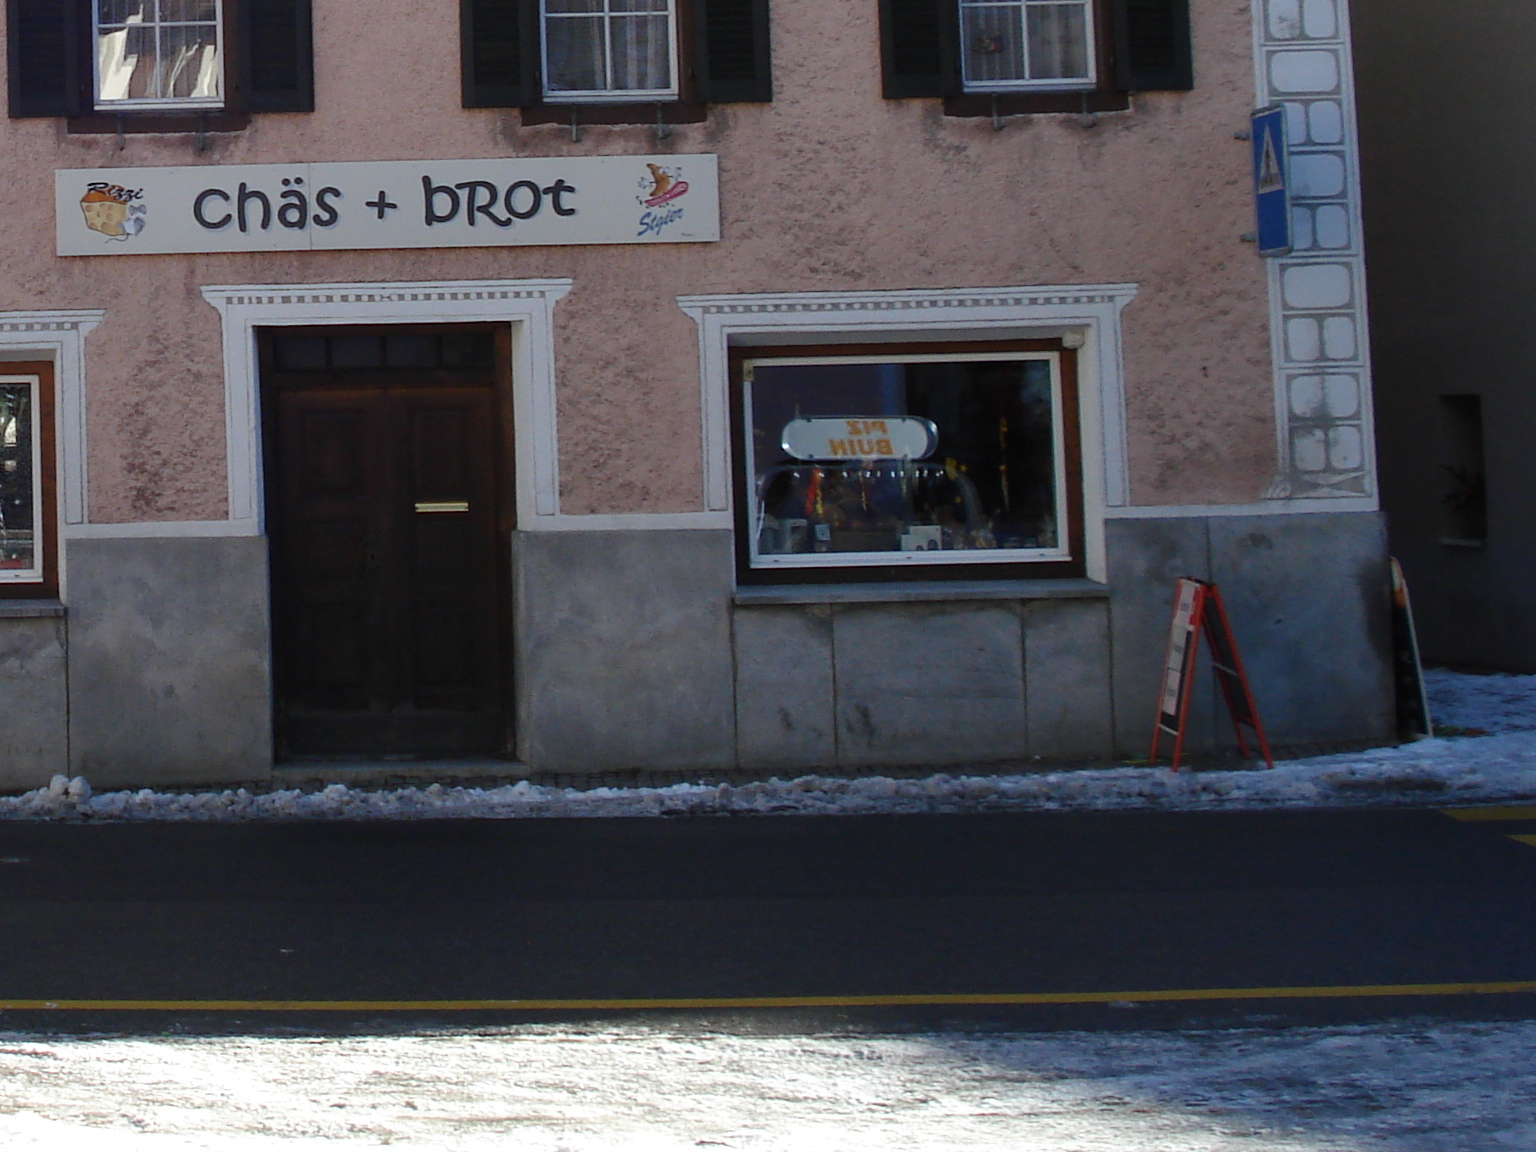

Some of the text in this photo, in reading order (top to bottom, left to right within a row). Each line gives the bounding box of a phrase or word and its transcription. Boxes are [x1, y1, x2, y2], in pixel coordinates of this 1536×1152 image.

[87, 182, 144, 202] Rizzi
[193, 177, 342, 233] chäs
[365, 190, 398, 220] +
